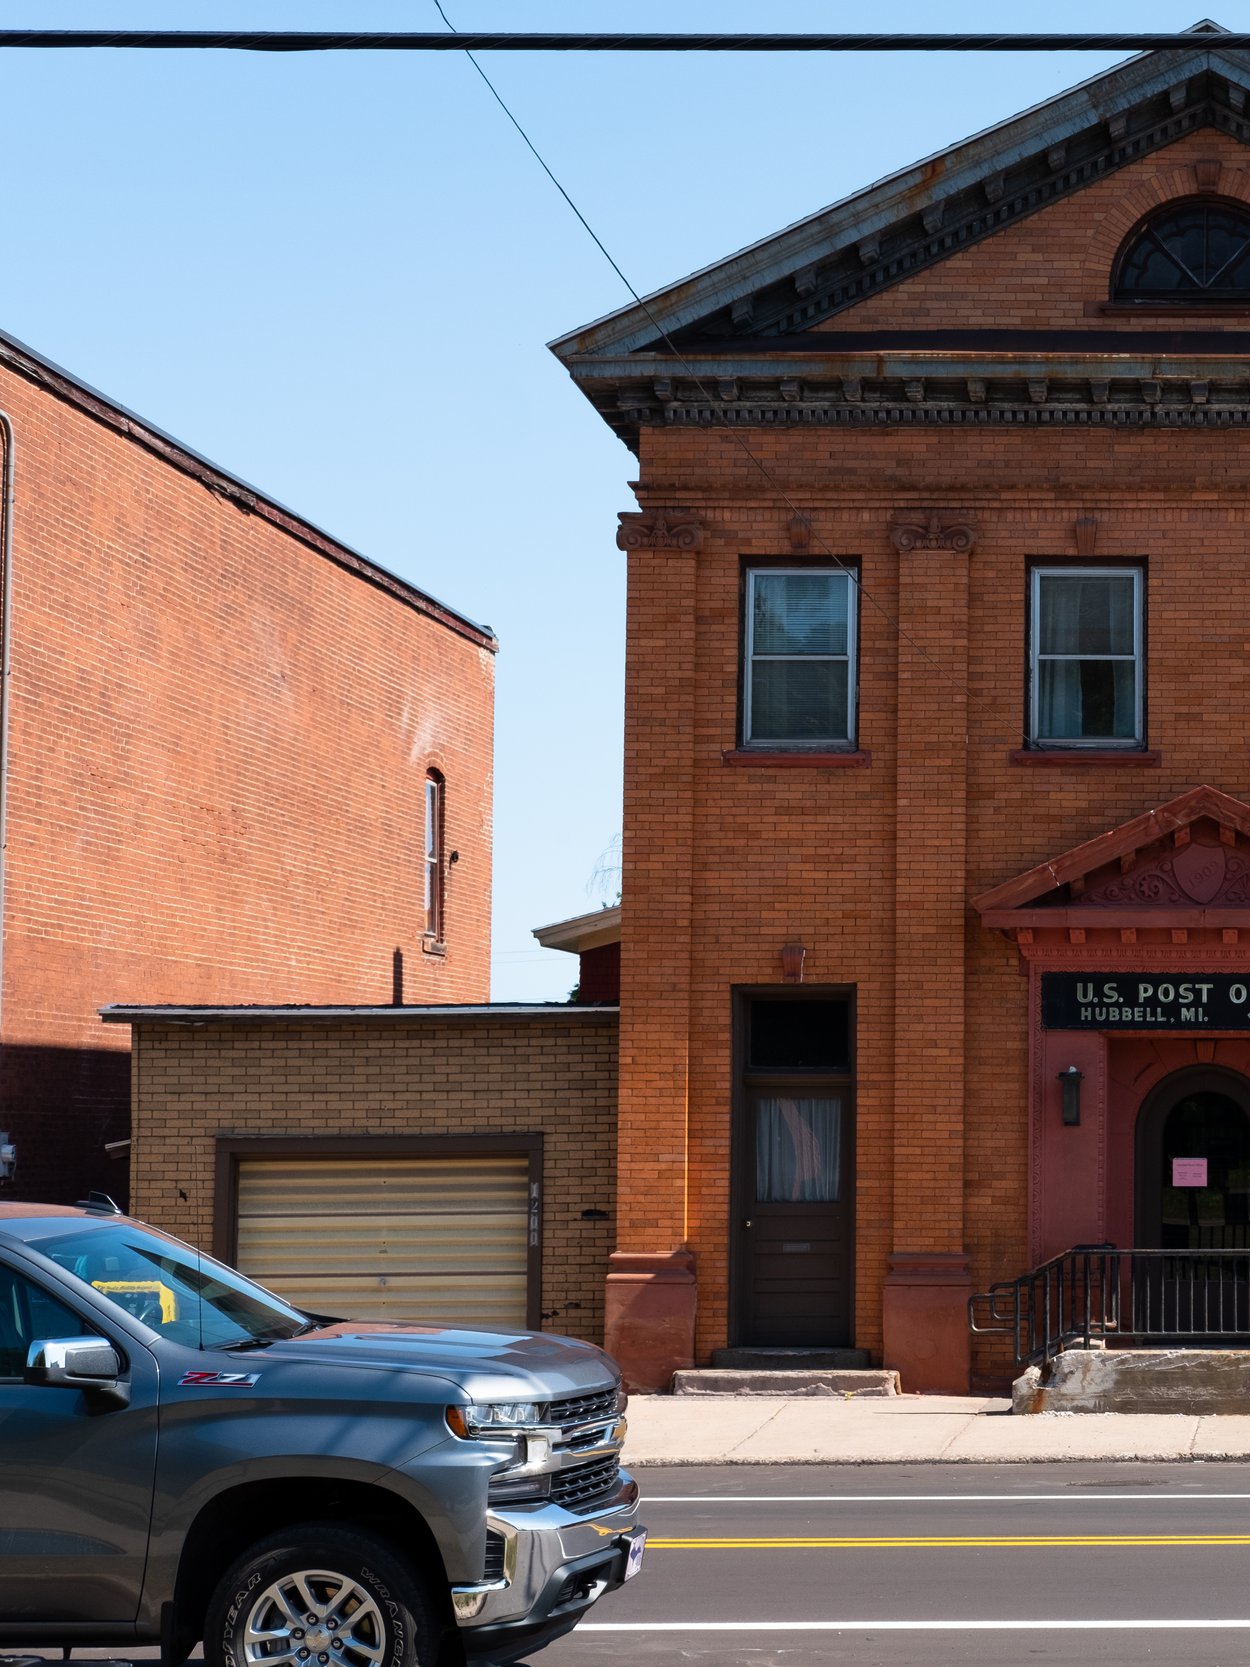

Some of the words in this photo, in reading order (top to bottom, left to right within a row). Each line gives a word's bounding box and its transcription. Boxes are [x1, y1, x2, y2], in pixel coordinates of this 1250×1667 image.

[1076, 982, 1124, 1003] U.S.
[1138, 983, 1214, 1003] POST
[1080, 1007, 1175, 1023] HUBBELL,
[1181, 1007, 1209, 1022] MI.
[177, 1370, 263, 1388] Z71
